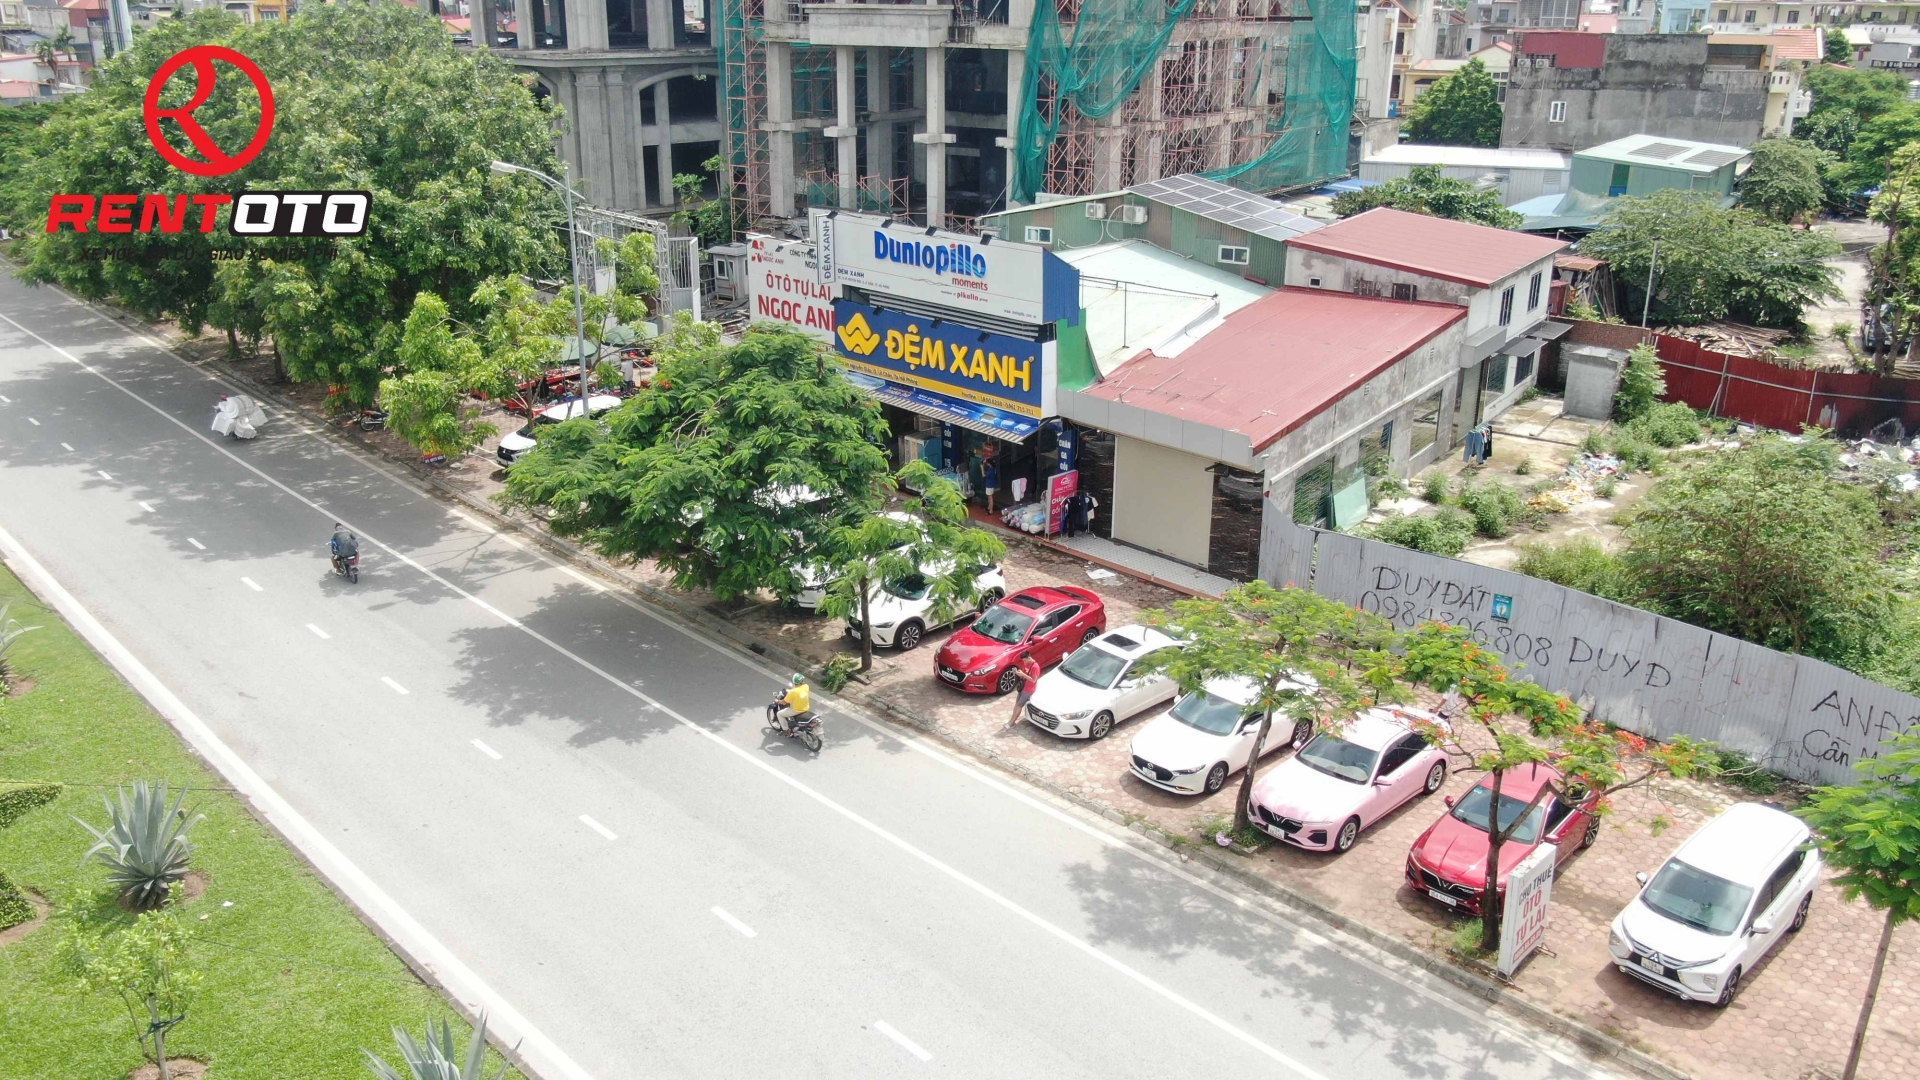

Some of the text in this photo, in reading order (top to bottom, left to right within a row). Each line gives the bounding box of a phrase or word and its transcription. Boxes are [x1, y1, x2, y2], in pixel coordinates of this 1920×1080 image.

[823, 221, 831, 252] XANH
[874, 230, 987, 278] Dunlopillo
[952, 277, 988, 291] moments
[885, 324, 946, 371] ĐỆM
